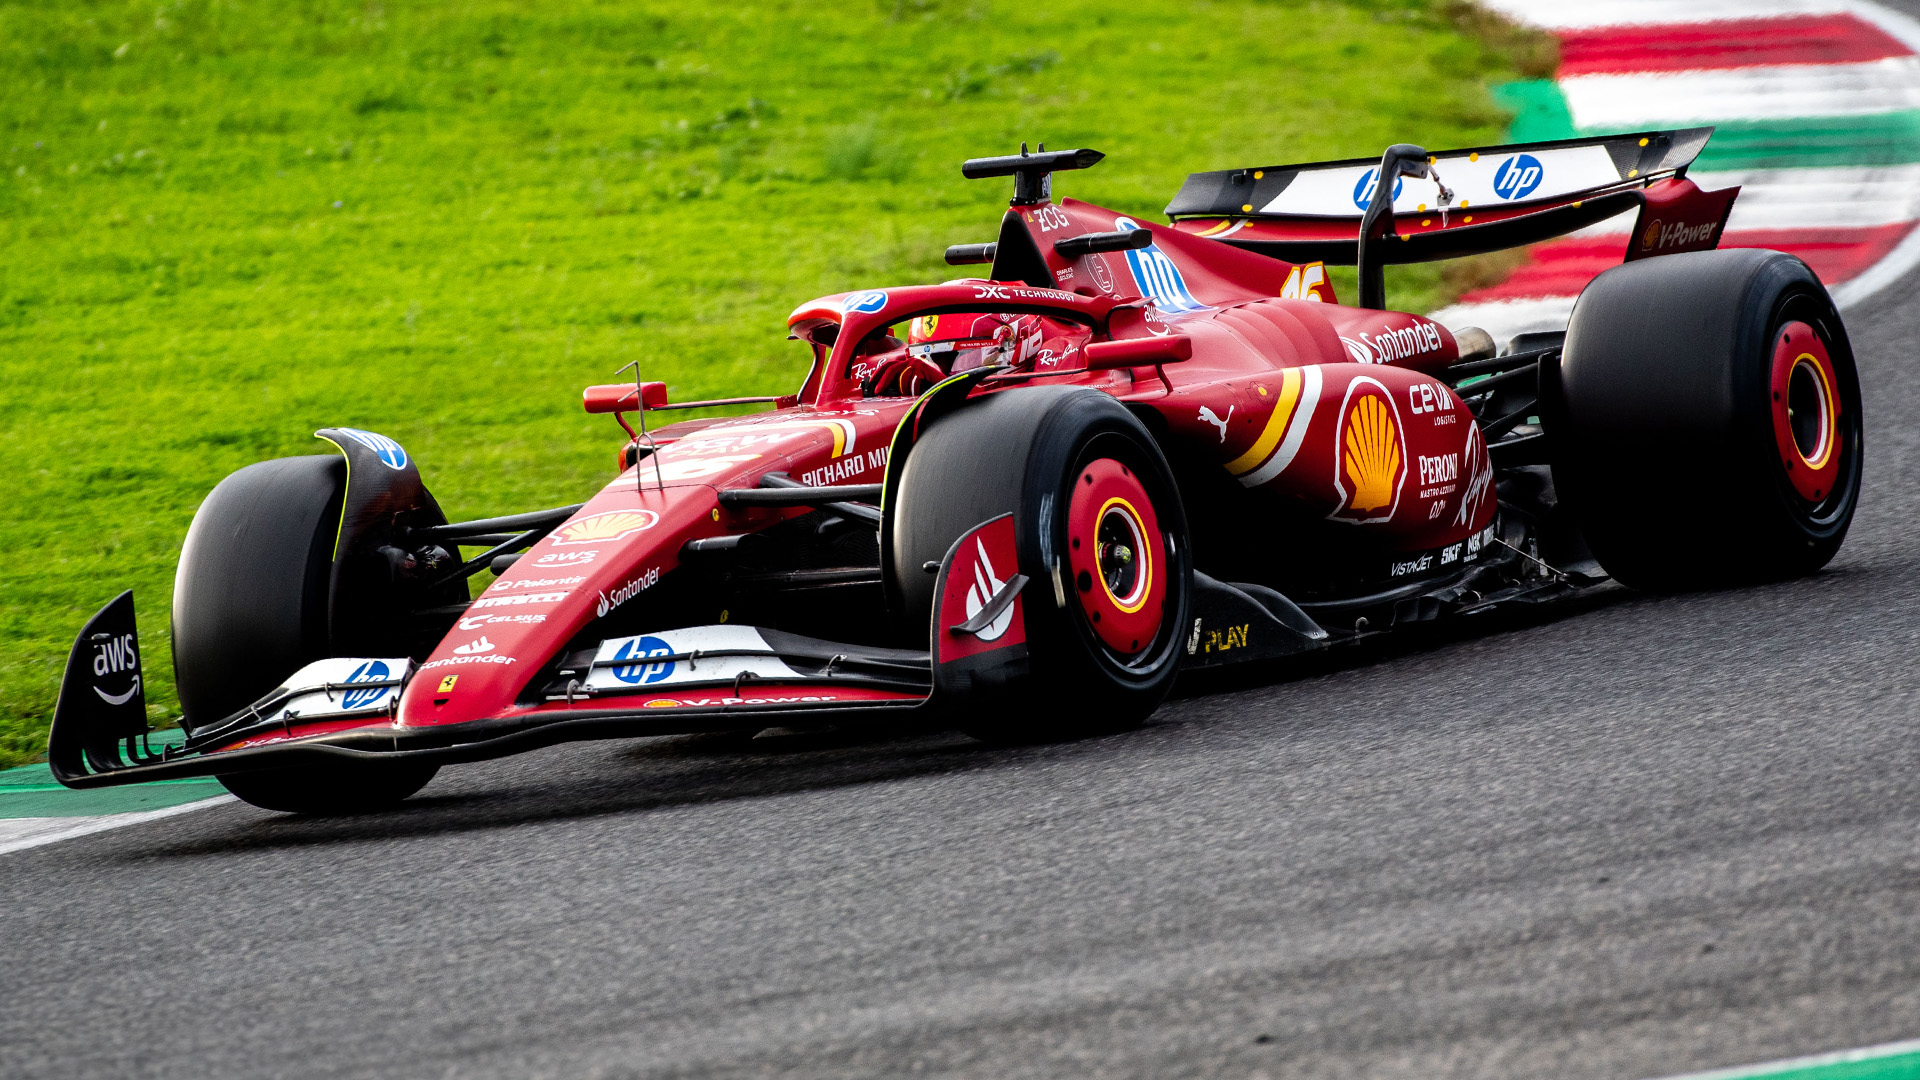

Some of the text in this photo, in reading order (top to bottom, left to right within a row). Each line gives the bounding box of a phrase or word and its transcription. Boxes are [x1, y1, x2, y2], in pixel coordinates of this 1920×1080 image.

[1497, 155, 1541, 199] hp
[1034, 206, 1070, 232] ZCG
[1659, 221, 1718, 249] V-Power
[1120, 220, 1191, 312] hp
[973, 286, 1075, 302] DXC TECHNOLOGY
[1144, 304, 1163, 322] aw
[1038, 344, 1079, 366] Ray-Ban
[1359, 319, 1443, 365] Santander
[852, 358, 887, 380] Ray-B
[1434, 414, 1456, 426] LOGISTICS
[341, 427, 402, 469] hp
[802, 455, 865, 487] RICHARD
[1419, 452, 1458, 486] PERONI
[1420, 488, 1440, 499] NASTRO
[537, 550, 600, 564] aws
[1441, 543, 1462, 565] SKF
[512, 576, 587, 589] Palantir
[610, 566, 660, 611] Santander
[487, 614, 547, 623] CELSIUS
[1205, 624, 1249, 653] PLAY
[93, 633, 137, 677] aws
[619, 636, 672, 684] hp
[345, 660, 388, 709] hp
[682, 696, 837, 707] V-Power
